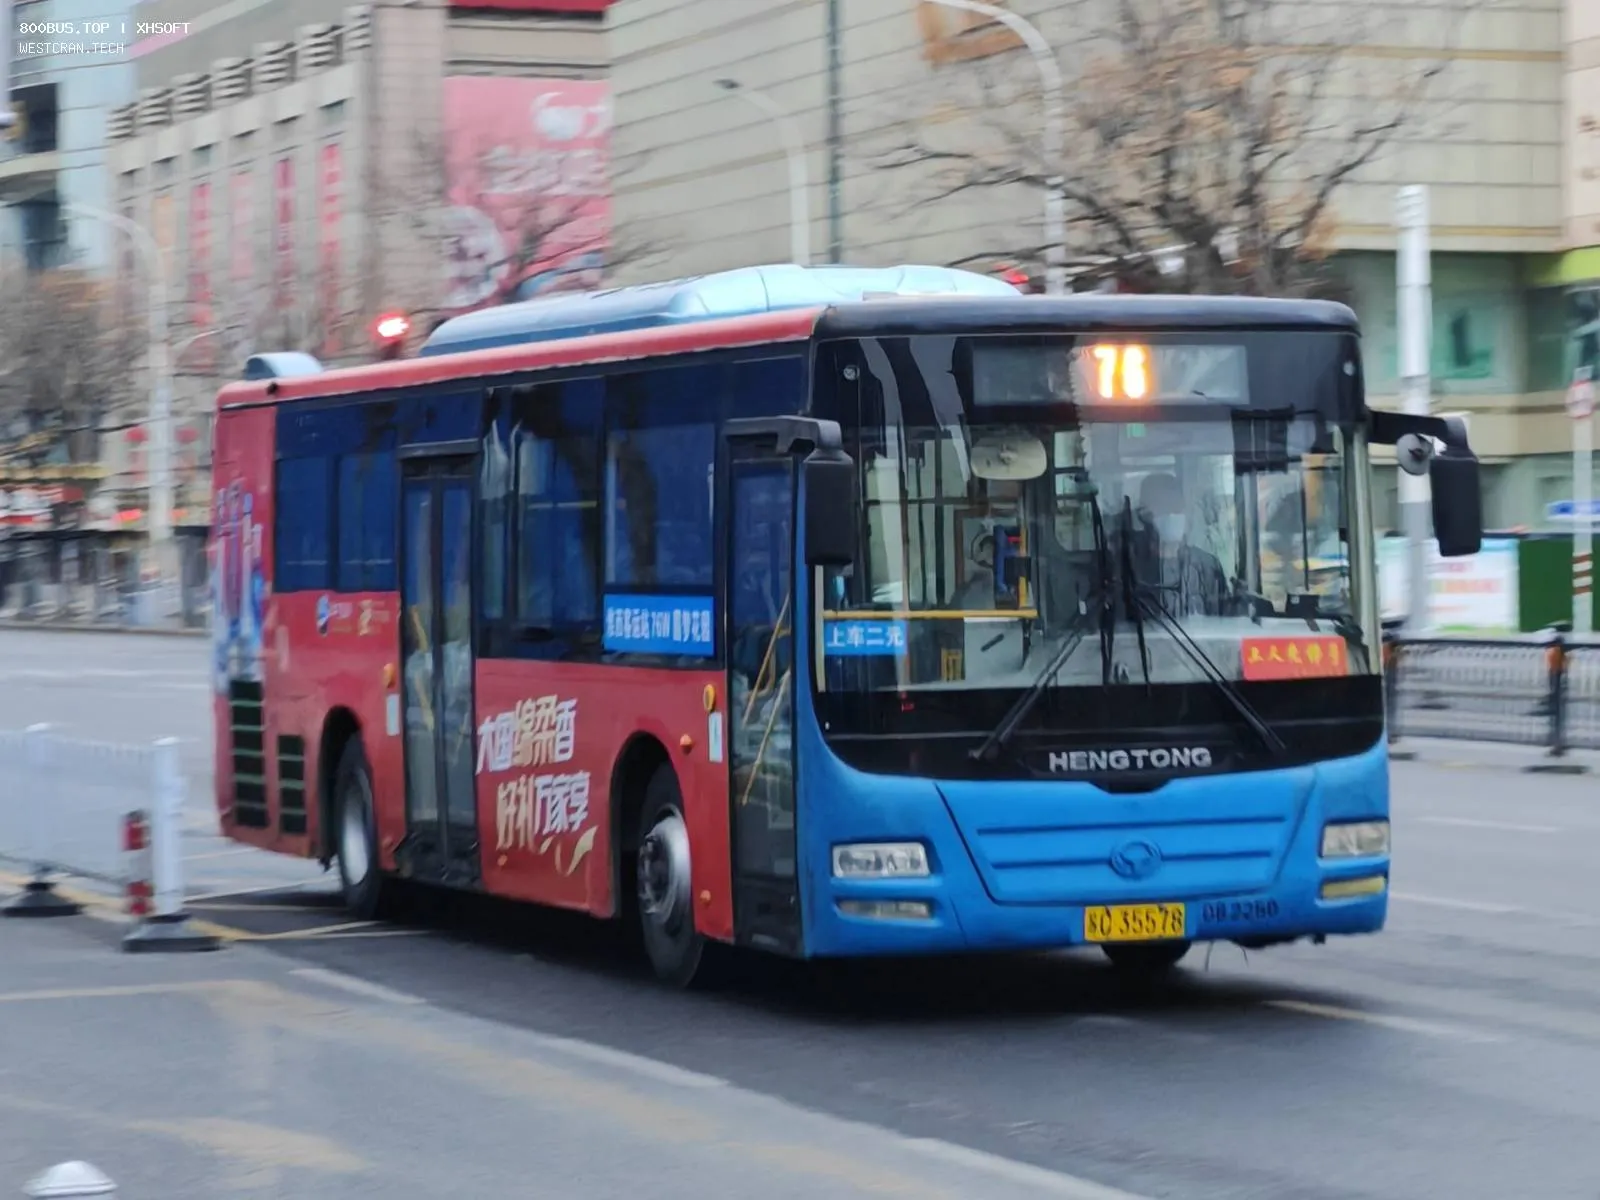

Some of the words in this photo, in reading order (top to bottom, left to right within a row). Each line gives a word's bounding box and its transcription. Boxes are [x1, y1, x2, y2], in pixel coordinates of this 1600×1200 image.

[827, 625, 905, 648] 上车二元
[1049, 747, 1212, 773] HENGTONG
